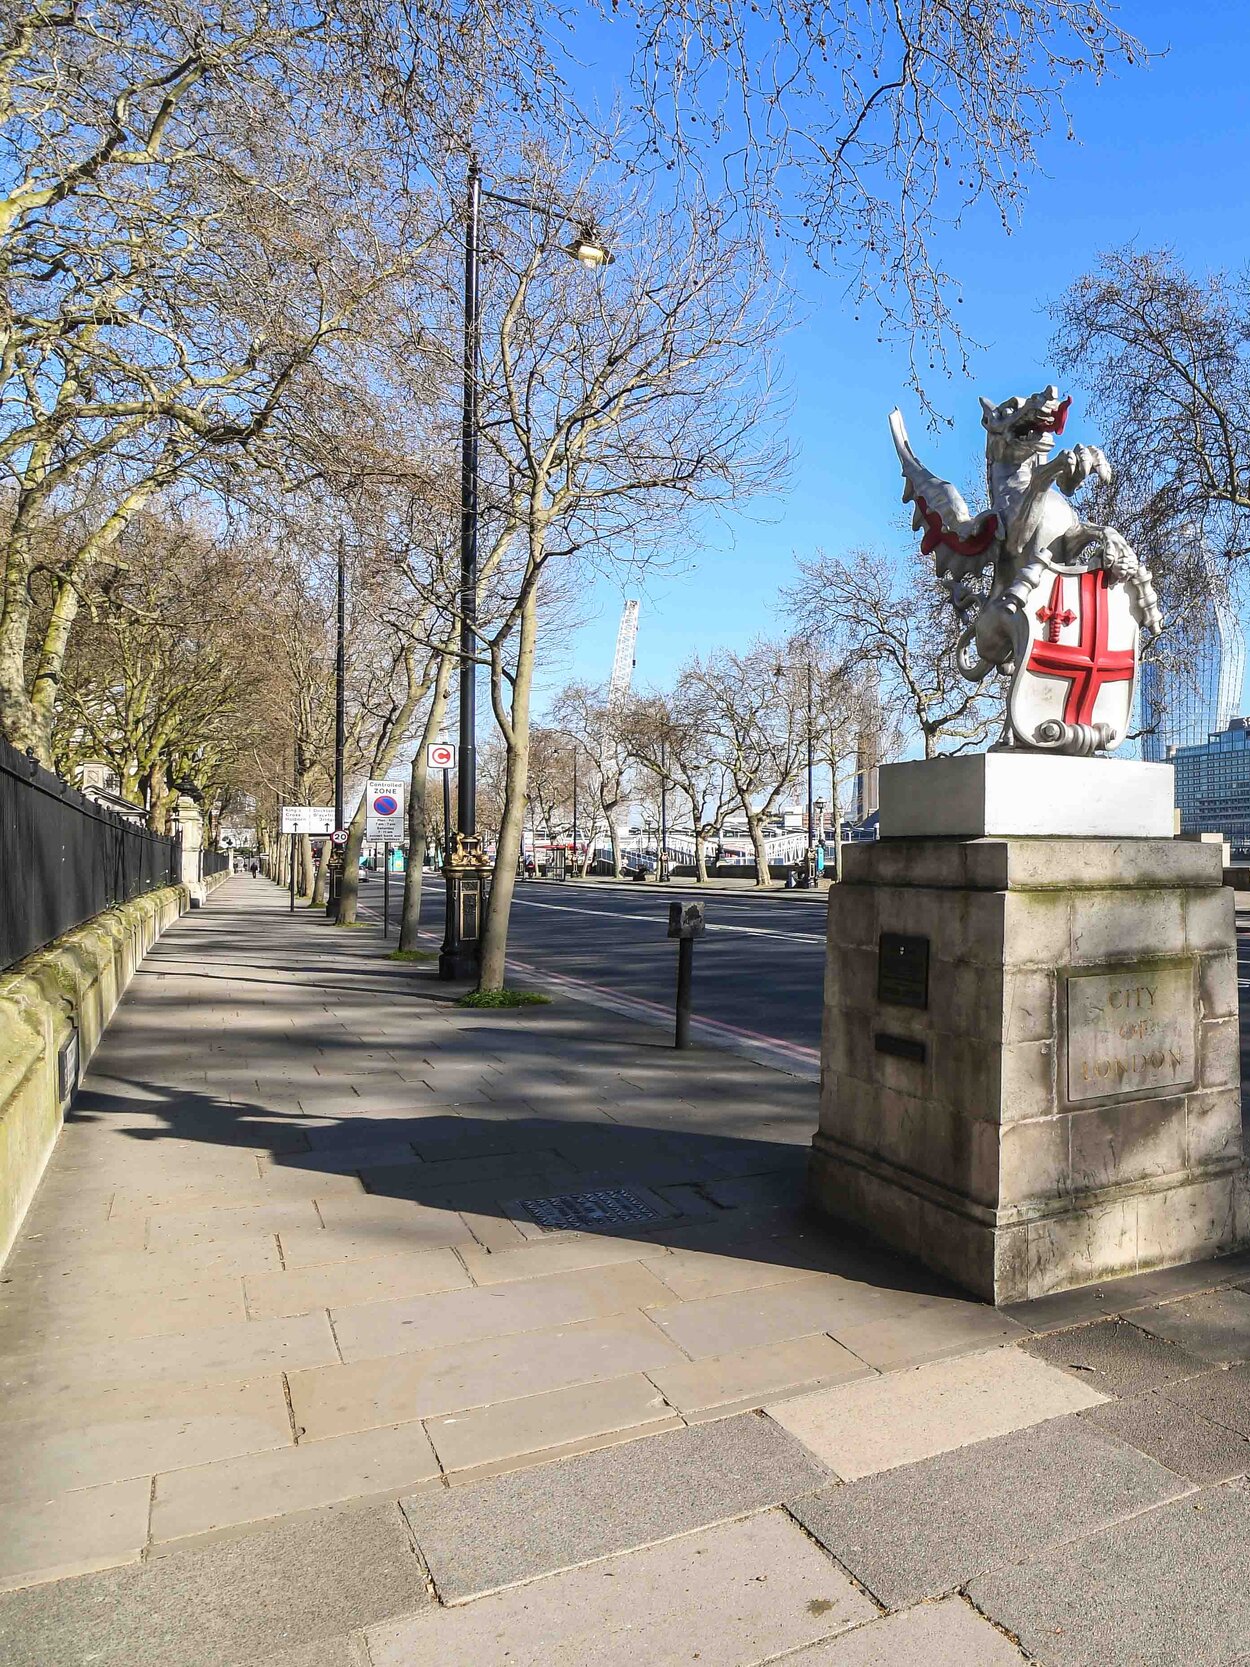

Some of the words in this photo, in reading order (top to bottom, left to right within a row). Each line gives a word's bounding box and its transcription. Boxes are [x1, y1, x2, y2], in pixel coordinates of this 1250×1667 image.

[1107, 985, 1158, 1009] CITY
[1119, 1020, 1149, 1041] OF
[1082, 1048, 1182, 1081] LONDON
